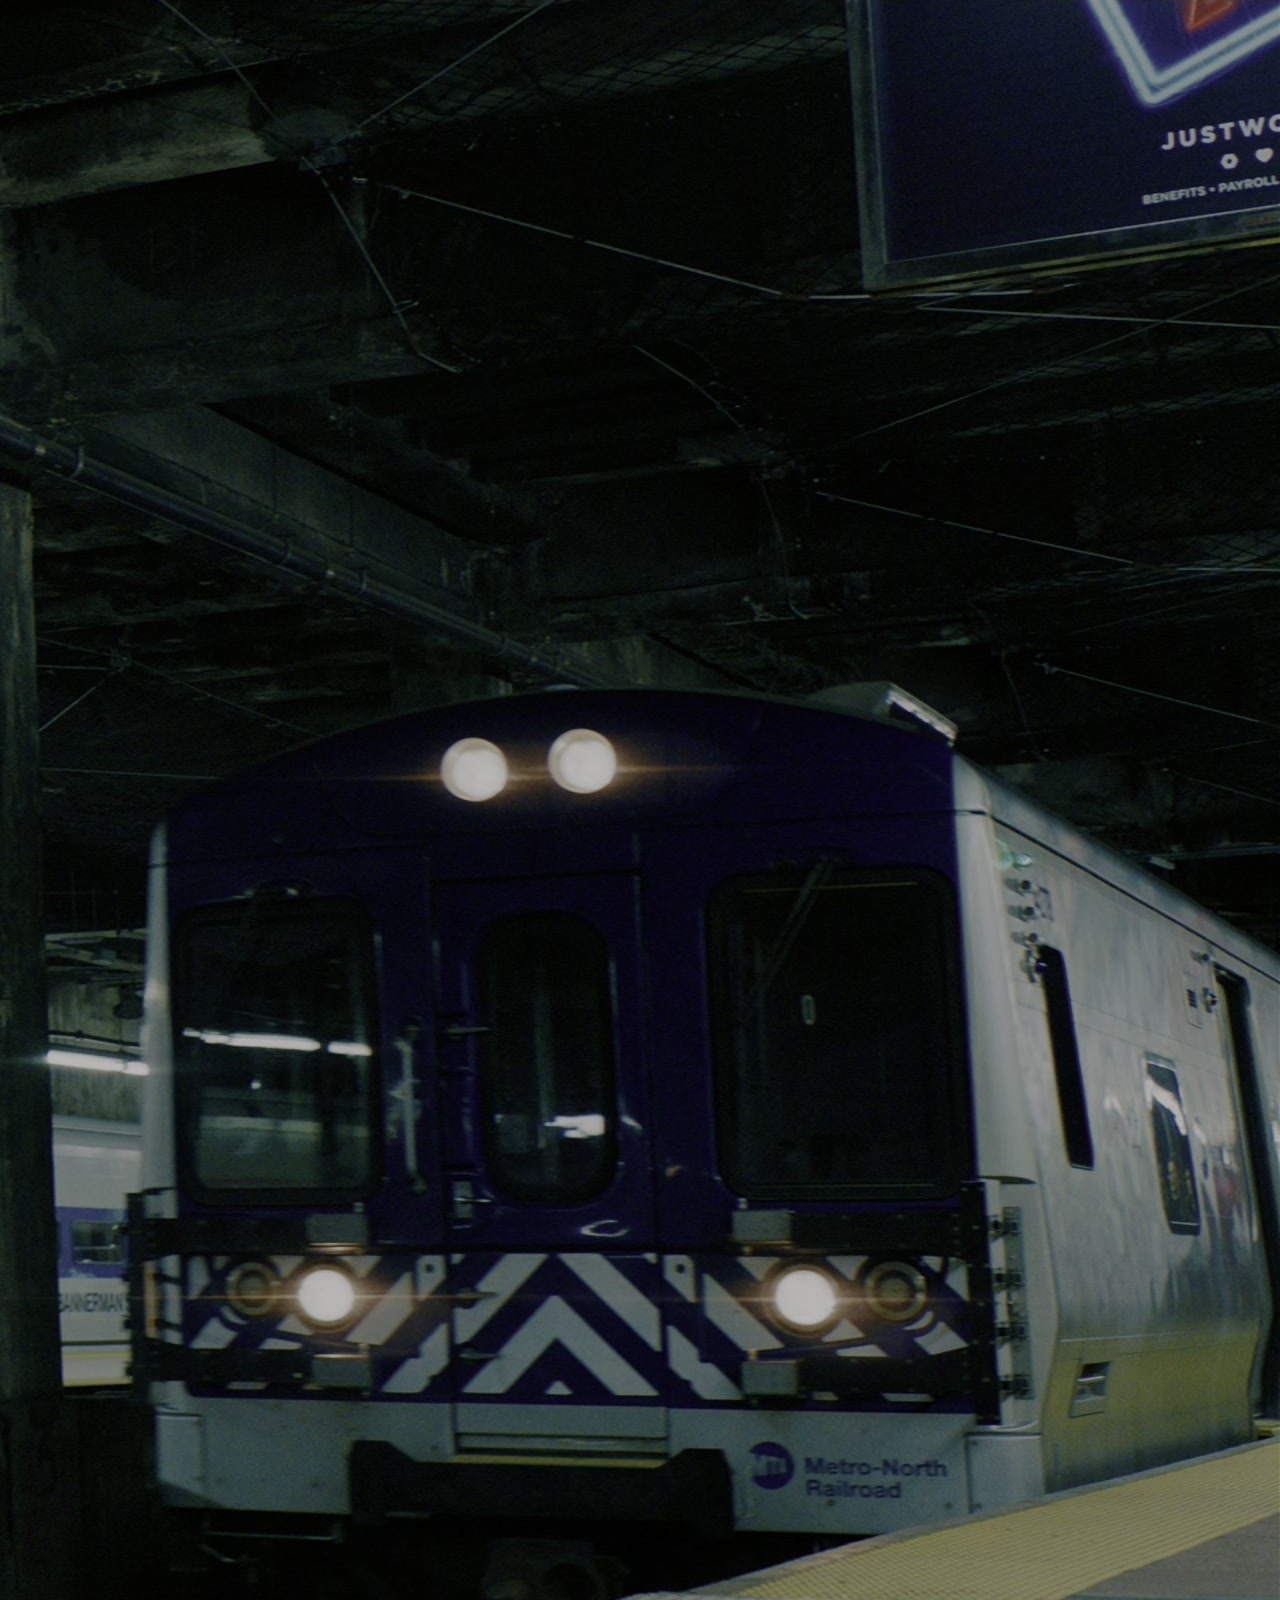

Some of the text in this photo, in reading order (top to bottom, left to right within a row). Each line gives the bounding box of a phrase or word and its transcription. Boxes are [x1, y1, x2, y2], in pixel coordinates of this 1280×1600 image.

[1142, 175, 1280, 205] BENEFITS PAYROLL
[804, 1457, 947, 1477] Metro-North
[806, 1480, 902, 1498] Railroad
